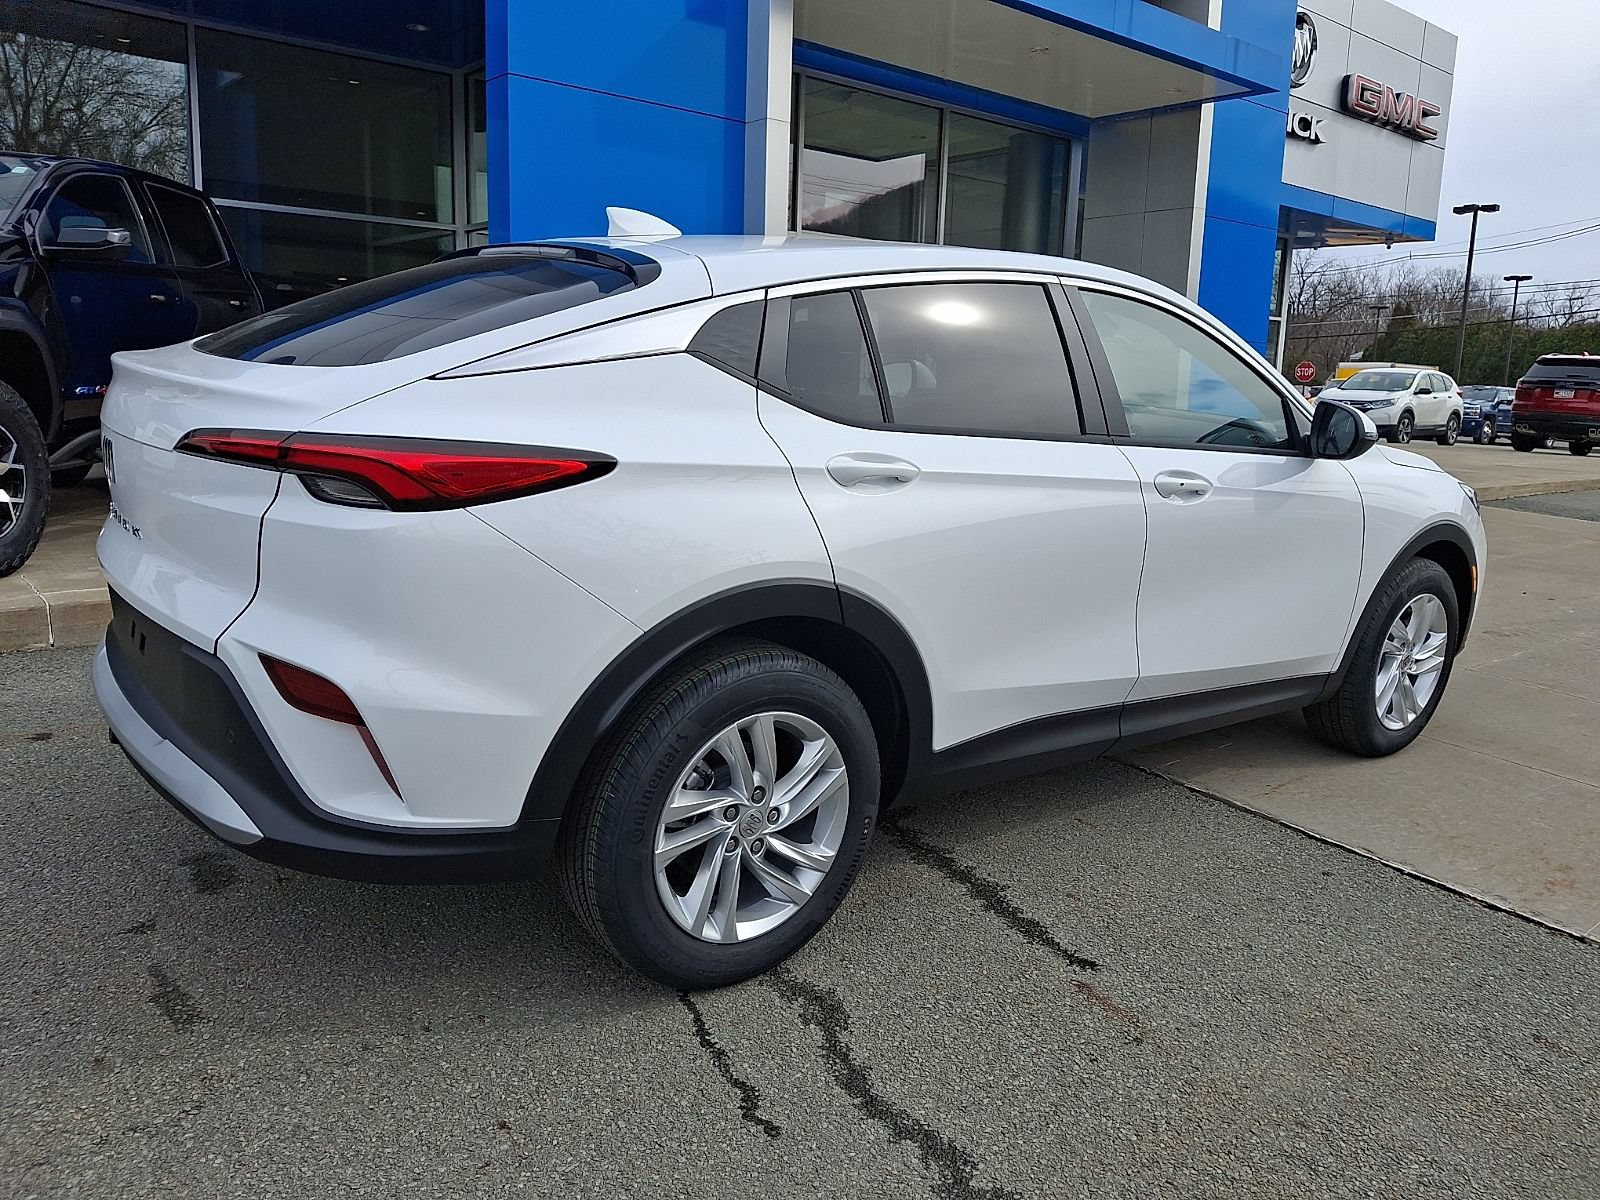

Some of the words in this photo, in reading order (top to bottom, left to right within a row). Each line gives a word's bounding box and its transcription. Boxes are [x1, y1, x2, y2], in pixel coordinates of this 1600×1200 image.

[1345, 73, 1441, 140] GMC
[1296, 367, 1314, 376] STOP
[628, 743, 682, 844] Continental
